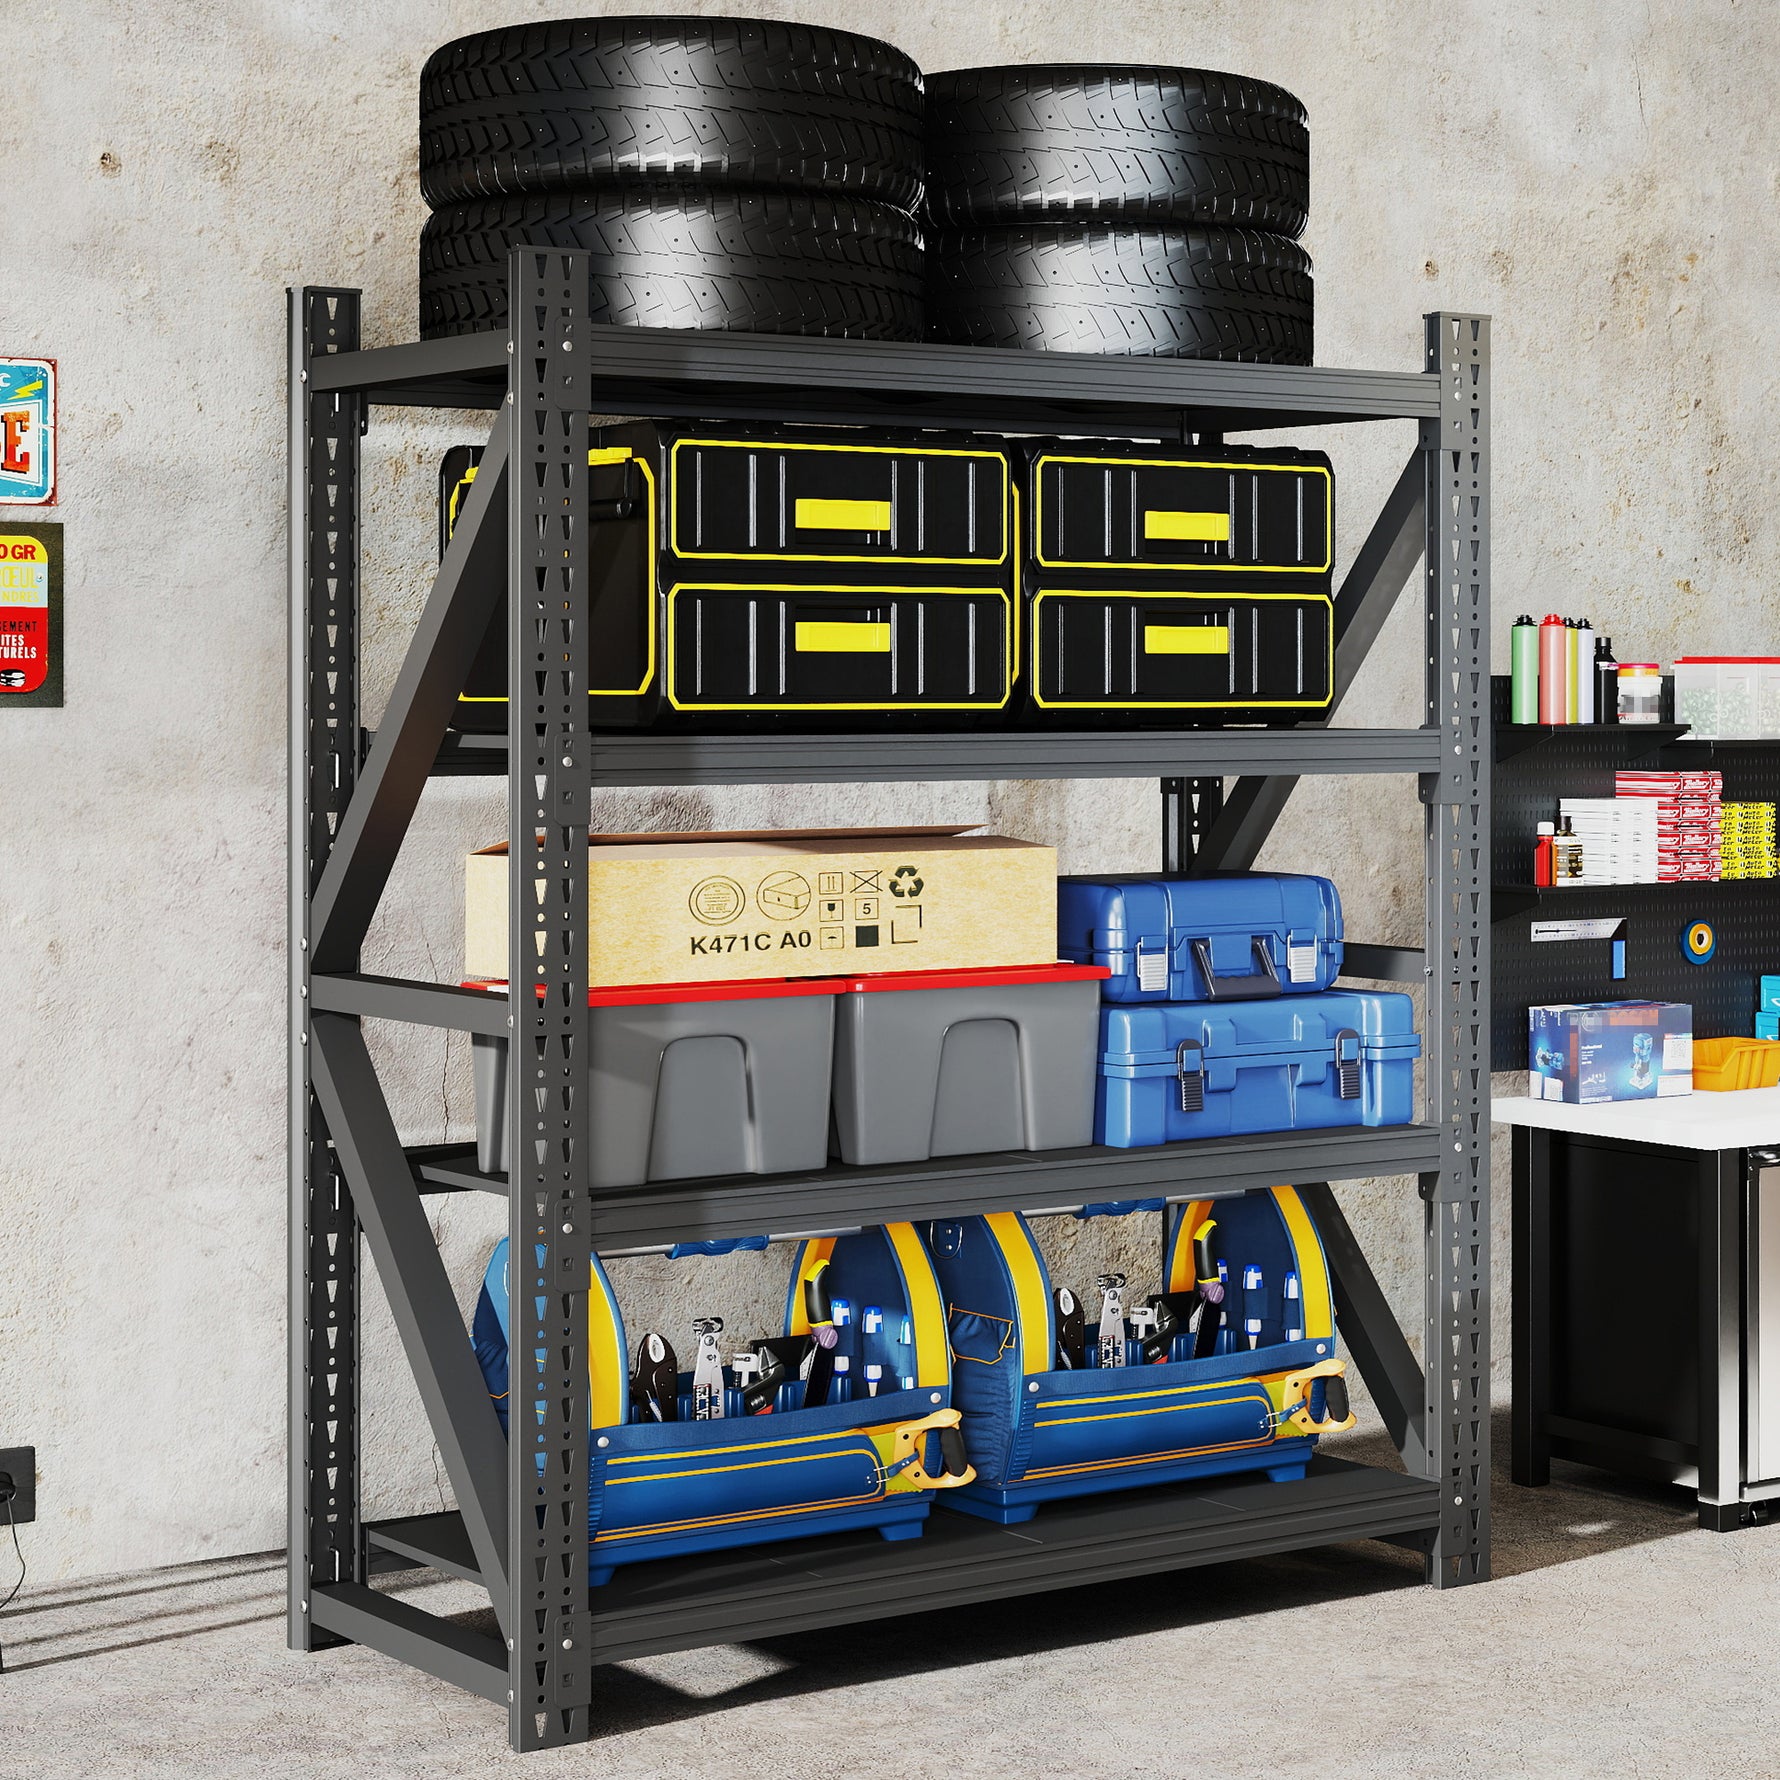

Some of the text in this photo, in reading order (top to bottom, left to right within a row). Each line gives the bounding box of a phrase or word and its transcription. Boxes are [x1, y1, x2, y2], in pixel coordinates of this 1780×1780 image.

[0, 410, 30, 475] E
[11, 544, 36, 560] GR
[0, 621, 37, 632] EMENT
[1, 634, 24, 647] ITES
[862, 903, 871, 914] 5
[690, 930, 812, 955] K471C A0
